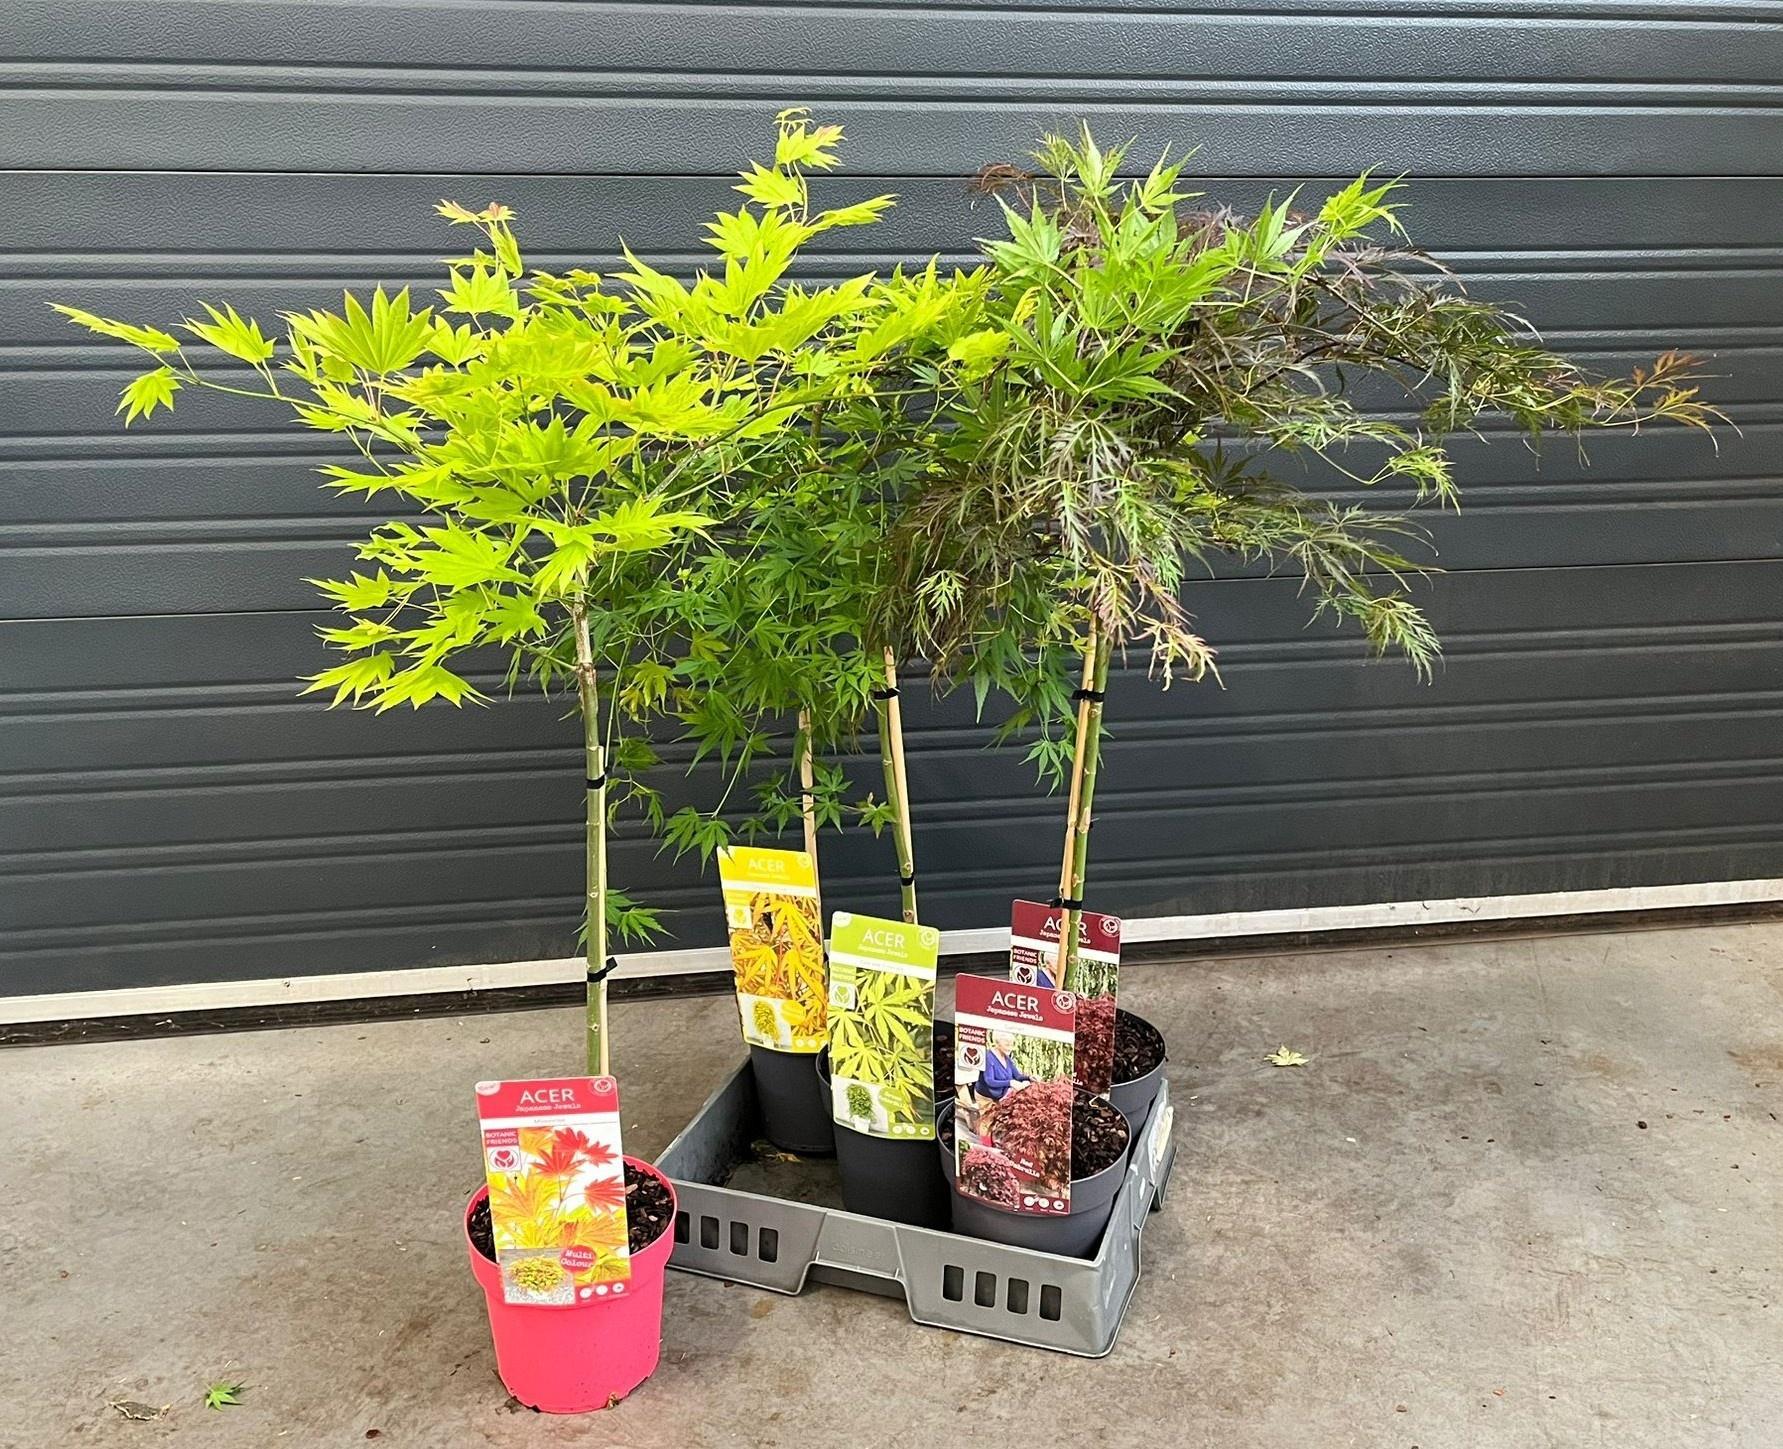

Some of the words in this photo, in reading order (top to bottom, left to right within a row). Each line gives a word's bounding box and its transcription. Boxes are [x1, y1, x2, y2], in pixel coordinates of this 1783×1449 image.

[749, 858, 785, 873] ACER
[862, 928, 906, 949] ACER
[992, 991, 1039, 1012] ACER
[520, 1088, 575, 1104] ACER
[1019, 1158, 1034, 1168] Red
[565, 1249, 593, 1260] Multi
[560, 1257, 593, 1268] Colour
